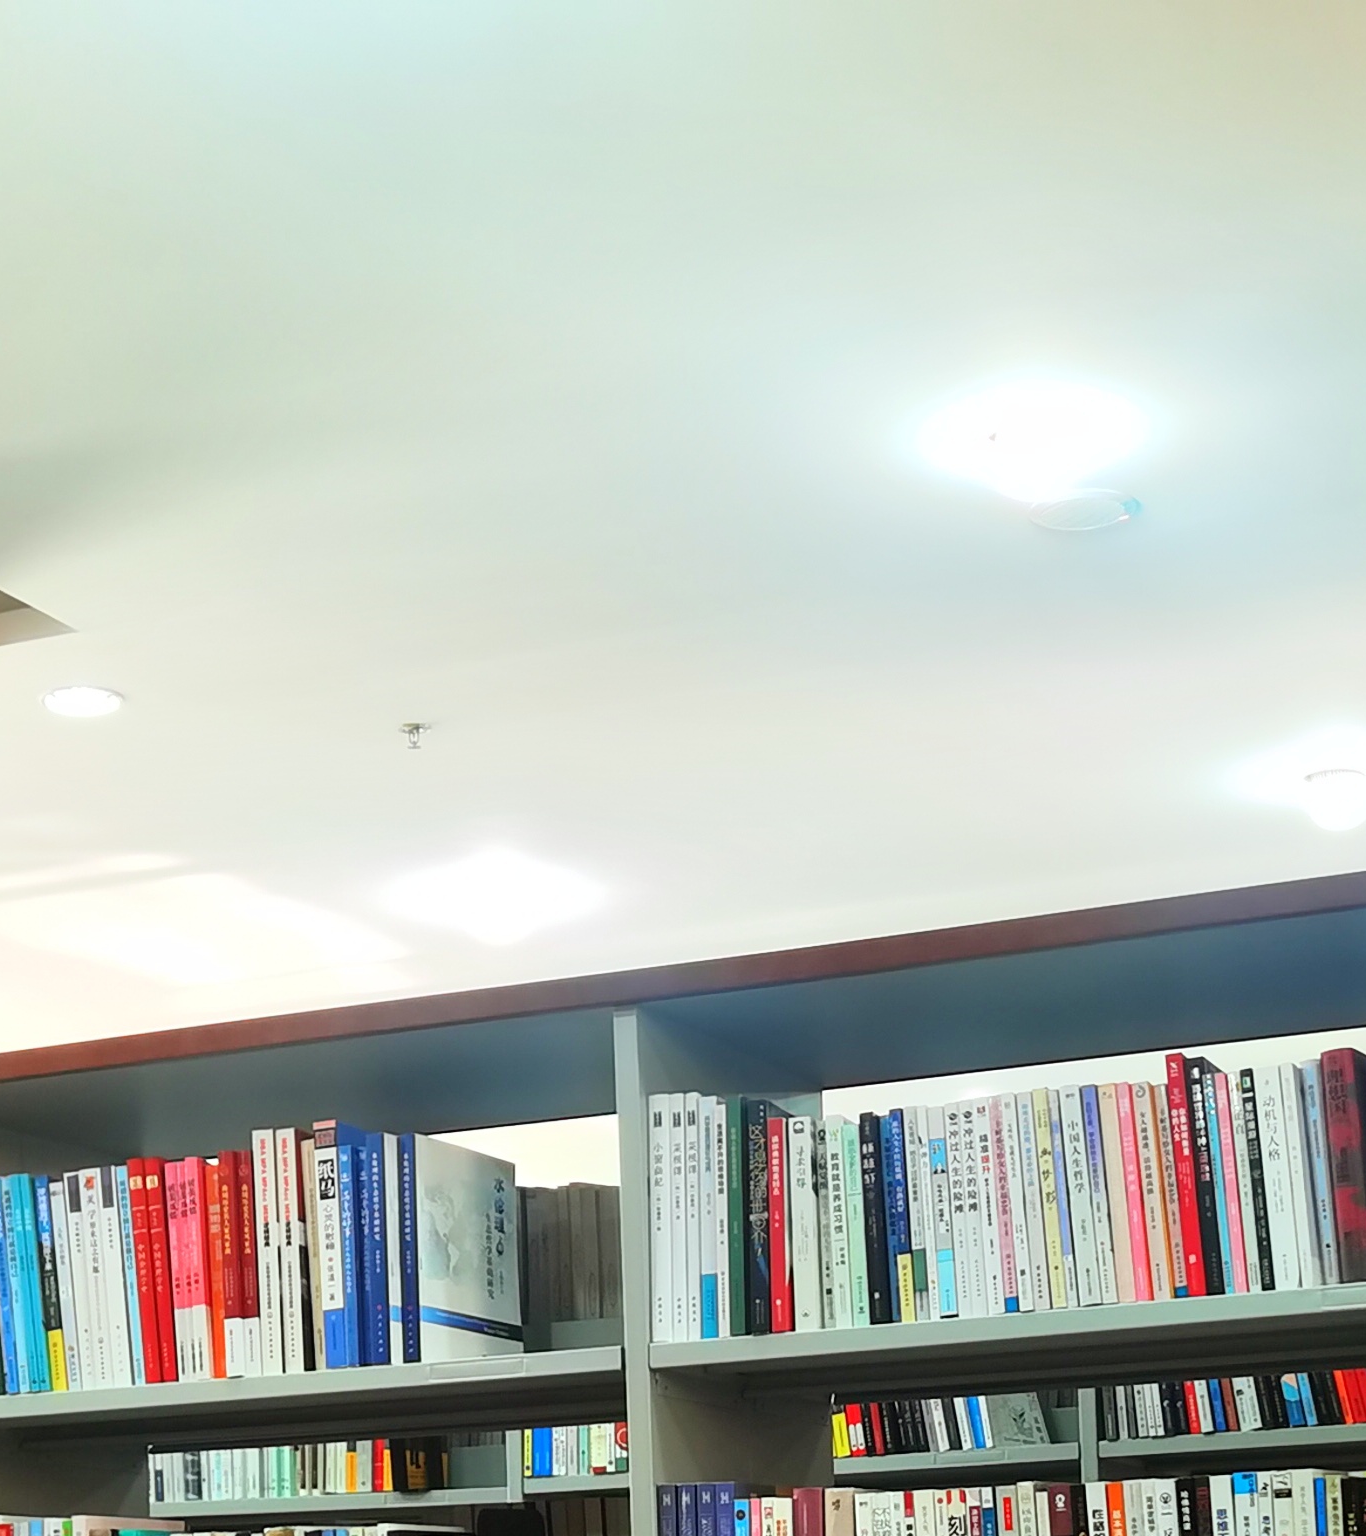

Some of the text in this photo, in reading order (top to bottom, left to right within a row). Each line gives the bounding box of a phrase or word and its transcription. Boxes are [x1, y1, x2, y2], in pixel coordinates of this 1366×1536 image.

[1263, 1095, 1281, 1161] 动机与人格
[318, 1160, 336, 1199] 纸马
